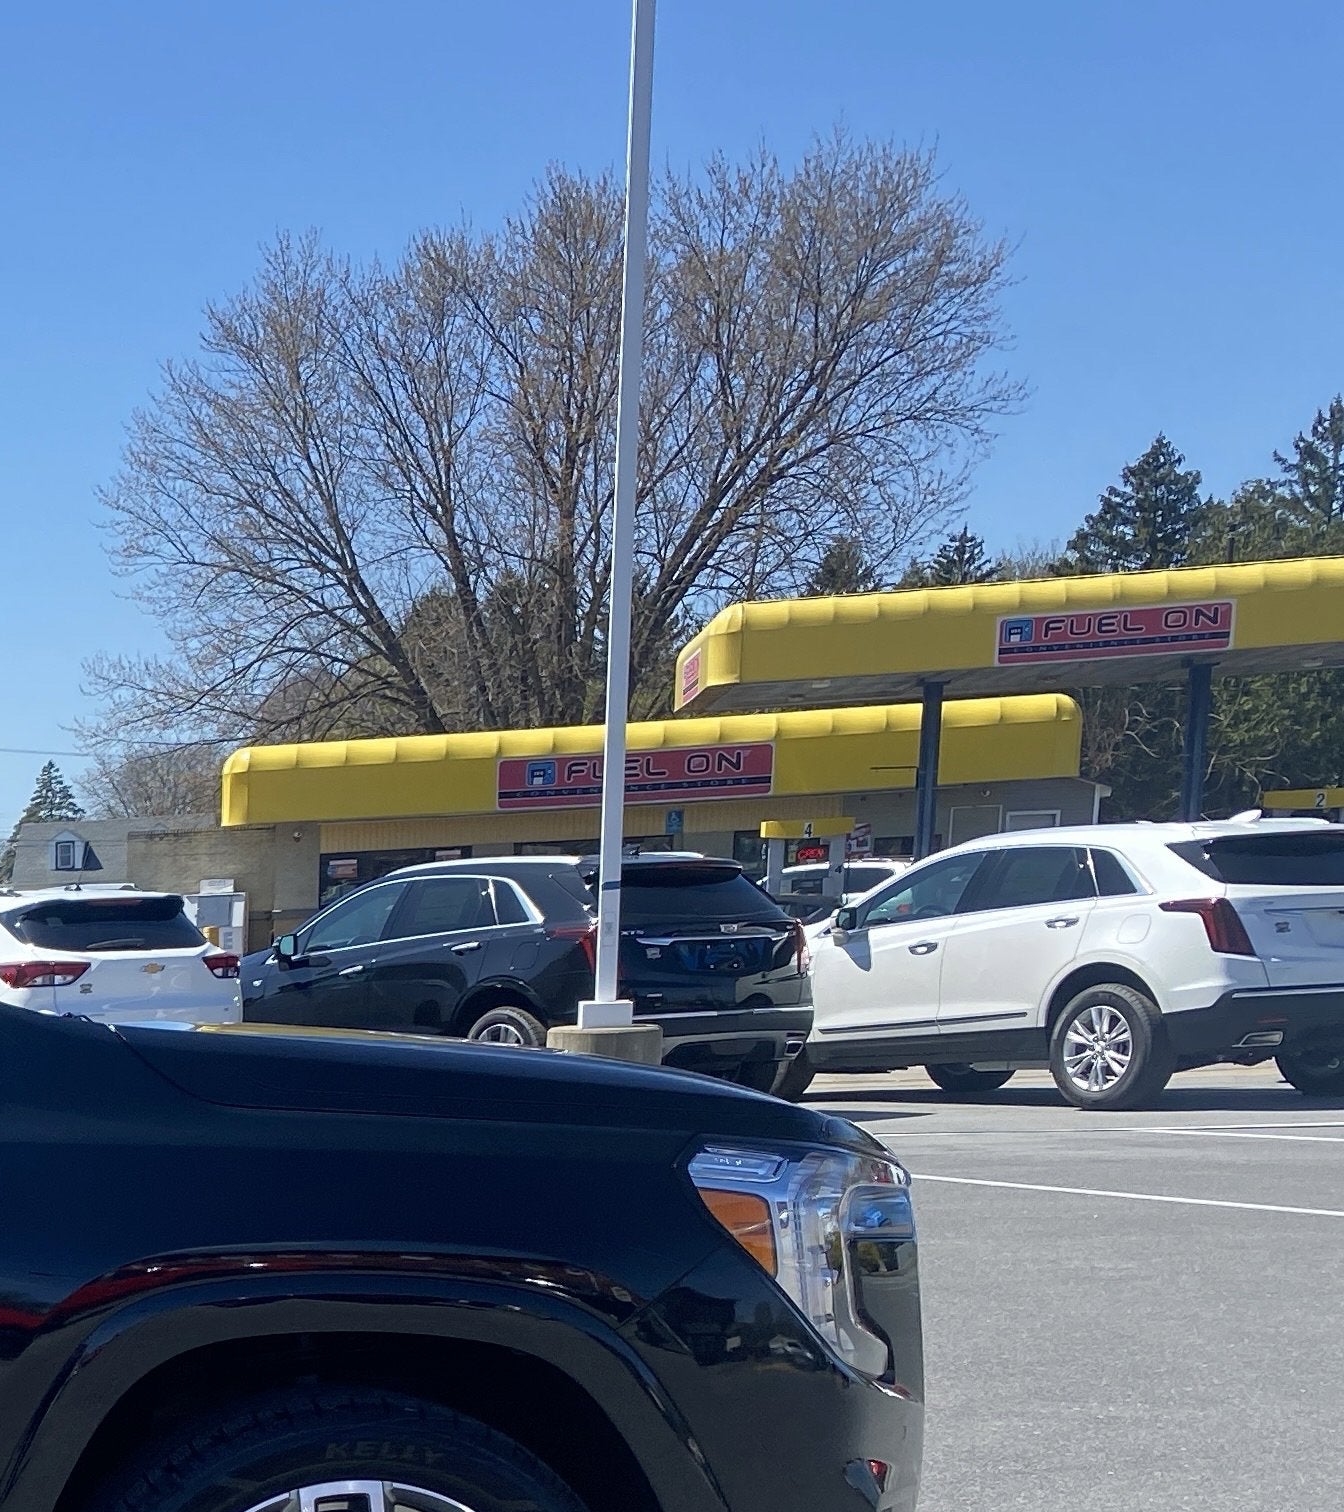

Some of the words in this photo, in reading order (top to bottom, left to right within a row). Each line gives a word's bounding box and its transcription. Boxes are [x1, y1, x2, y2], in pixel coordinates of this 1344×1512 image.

[1043, 612, 1145, 638] FUEL
[1164, 606, 1220, 628] ON
[685, 750, 743, 774] ON
[516, 783, 666, 797] CONVENNCE
[1315, 793, 1325, 808] 2
[804, 823, 812, 838] 4
[834, 865, 842, 874] 4
